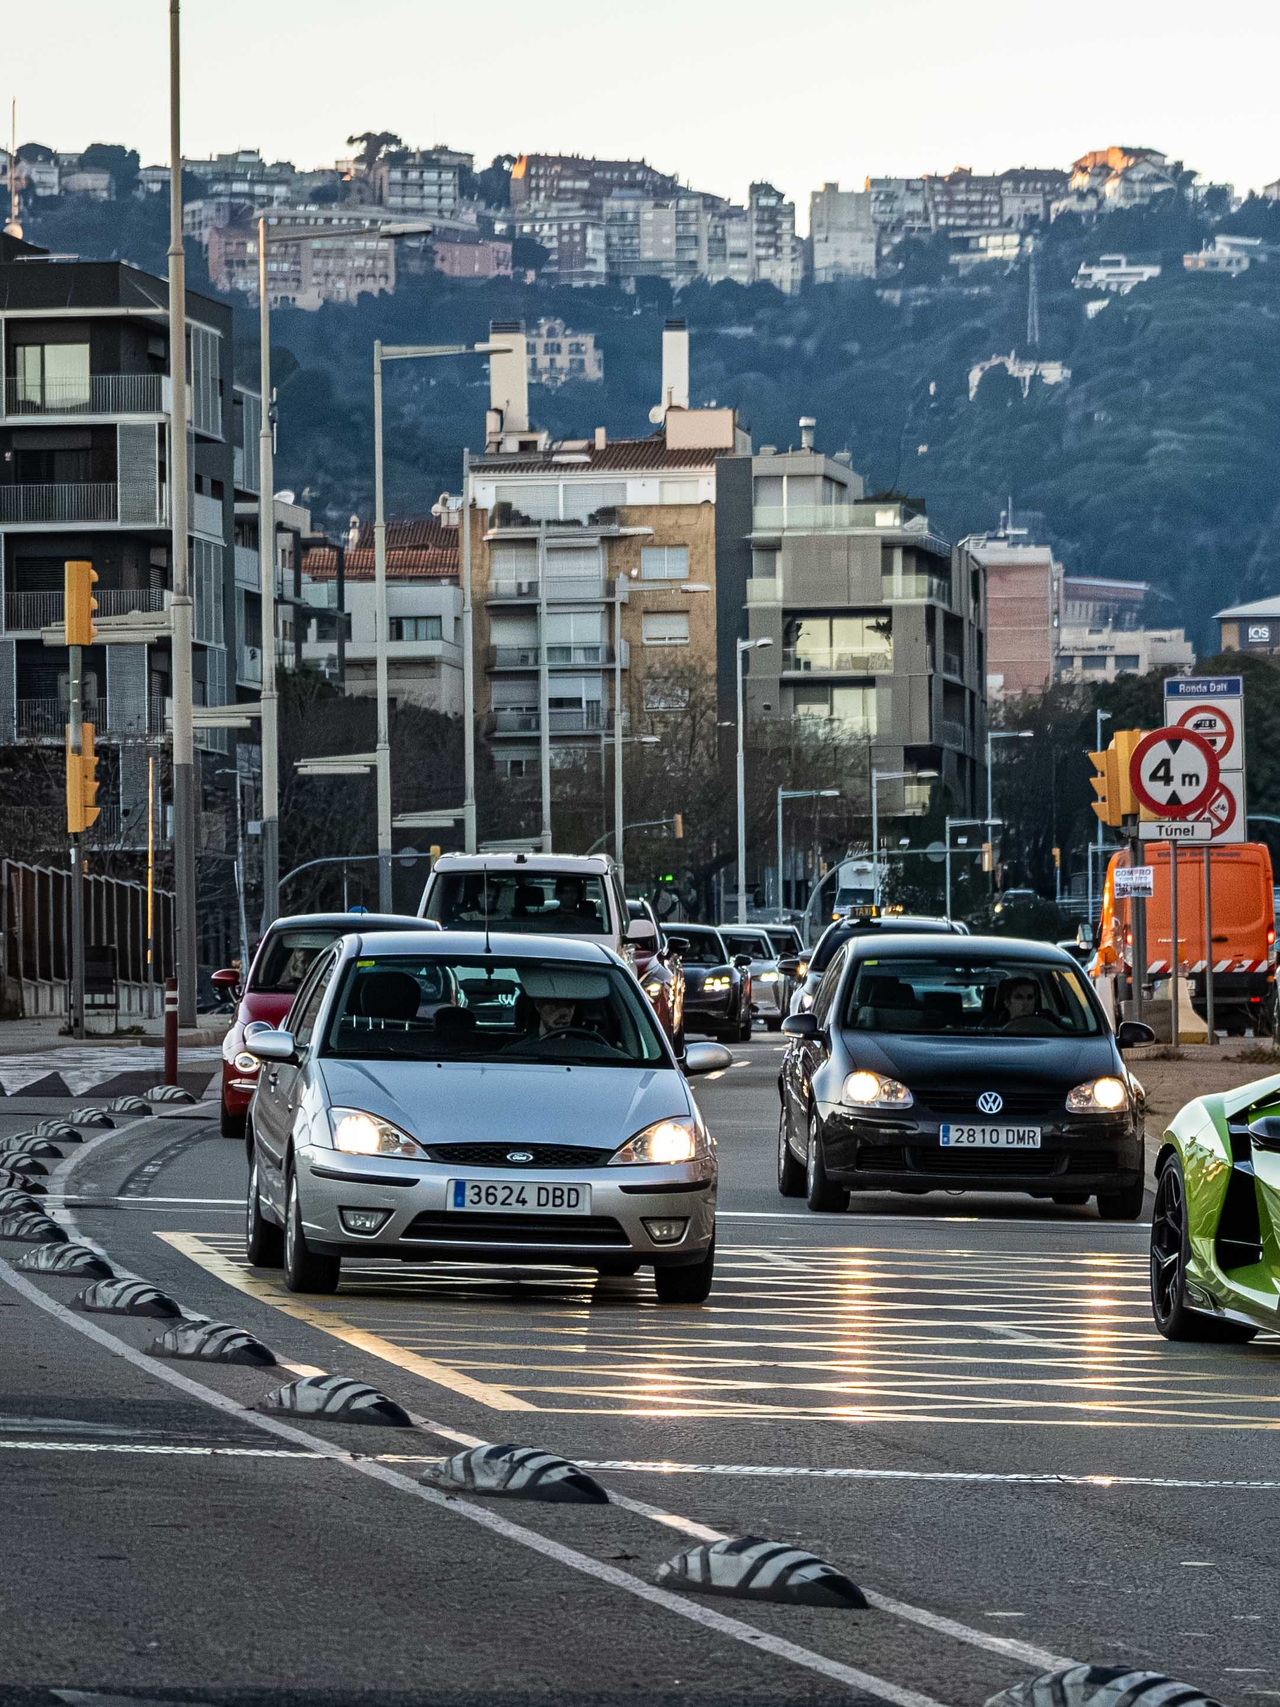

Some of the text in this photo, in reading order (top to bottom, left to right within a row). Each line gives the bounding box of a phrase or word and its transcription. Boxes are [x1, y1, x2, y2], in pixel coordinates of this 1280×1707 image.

[1178, 682, 1227, 693] Ronda Dalt
[1149, 758, 1200, 787] 4 m
[1156, 825, 1195, 837] Túnel
[1115, 868, 1152, 877] COMPRO
[954, 1128, 1037, 1146] 2810 DMR
[469, 1184, 580, 1208] 3624 DBD
